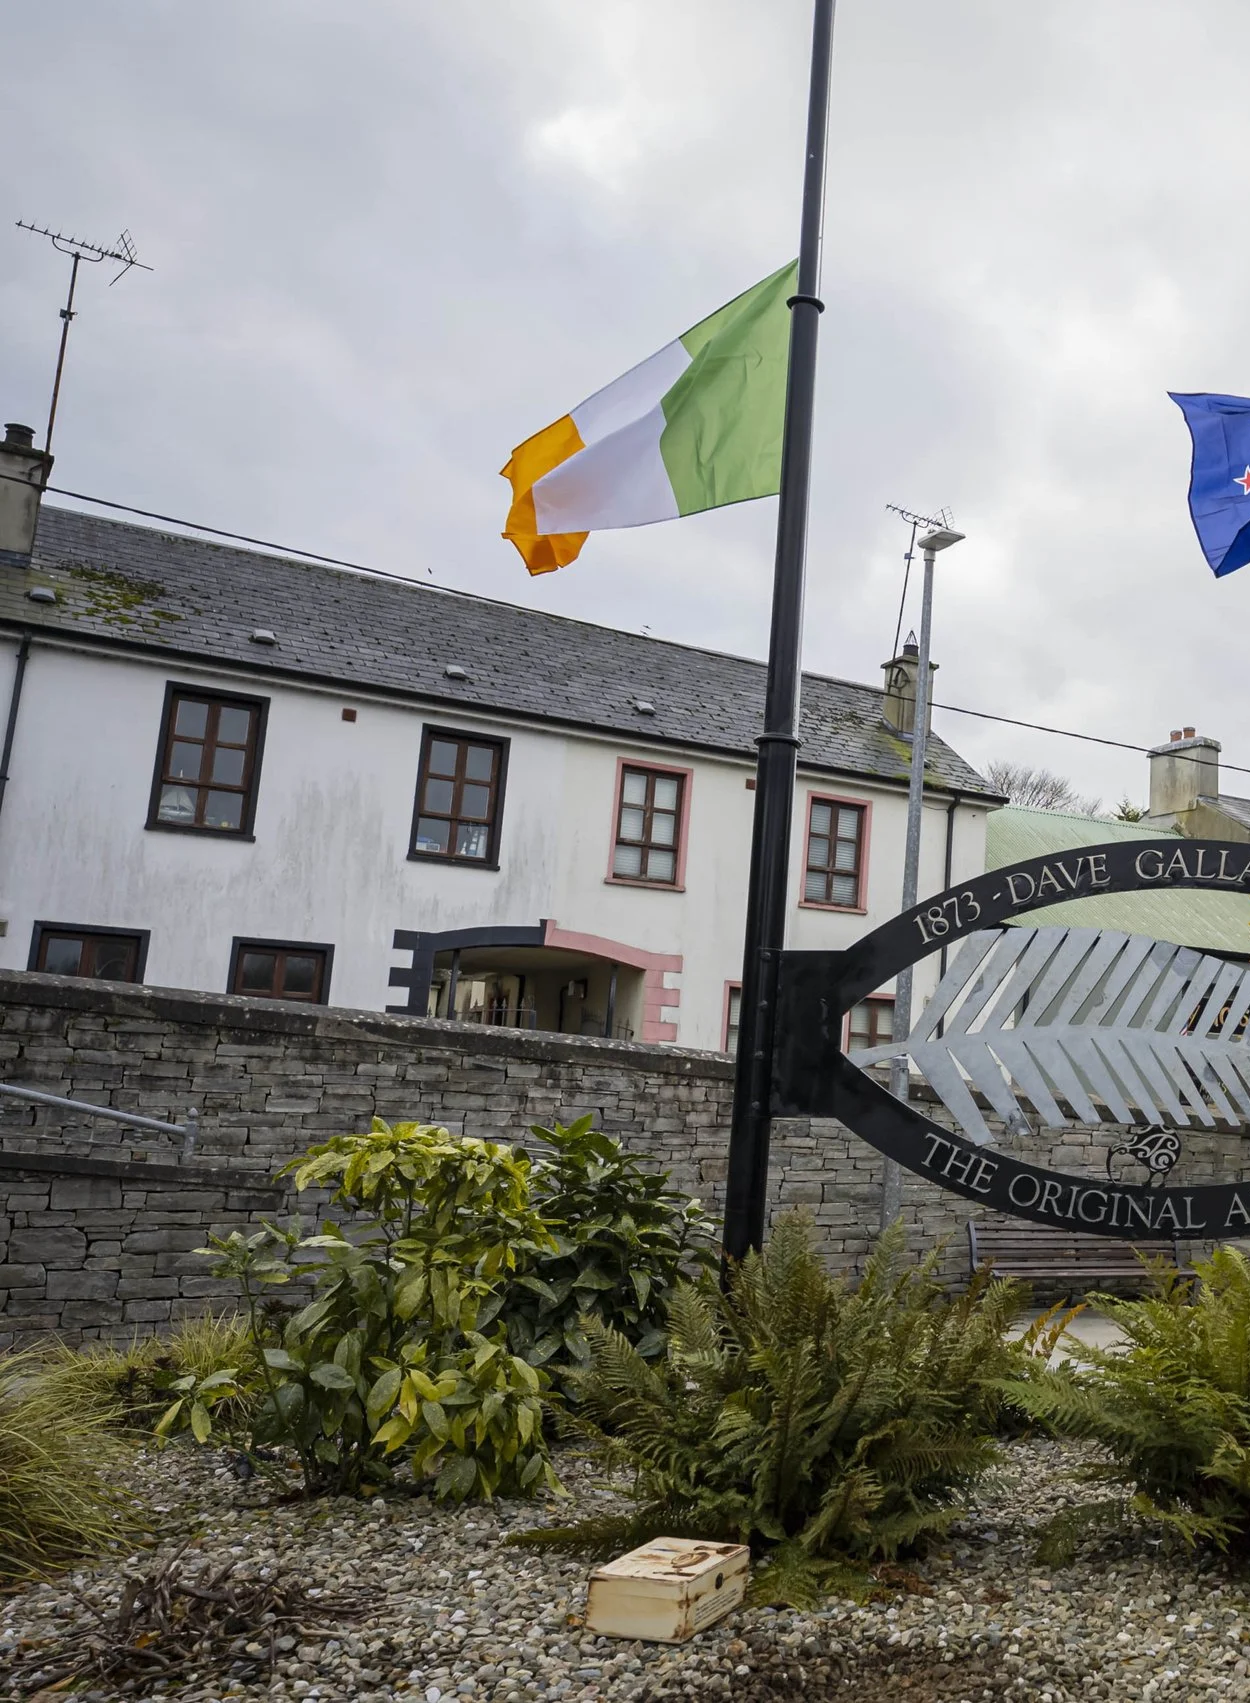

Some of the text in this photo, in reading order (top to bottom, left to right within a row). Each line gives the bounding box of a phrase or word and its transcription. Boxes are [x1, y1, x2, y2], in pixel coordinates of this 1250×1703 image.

[913, 891, 981, 945] 1873
[1006, 853, 1111, 905] DAVE
[921, 1132, 999, 1194] THE
[1008, 1173, 1206, 1230] ORIGINAL
